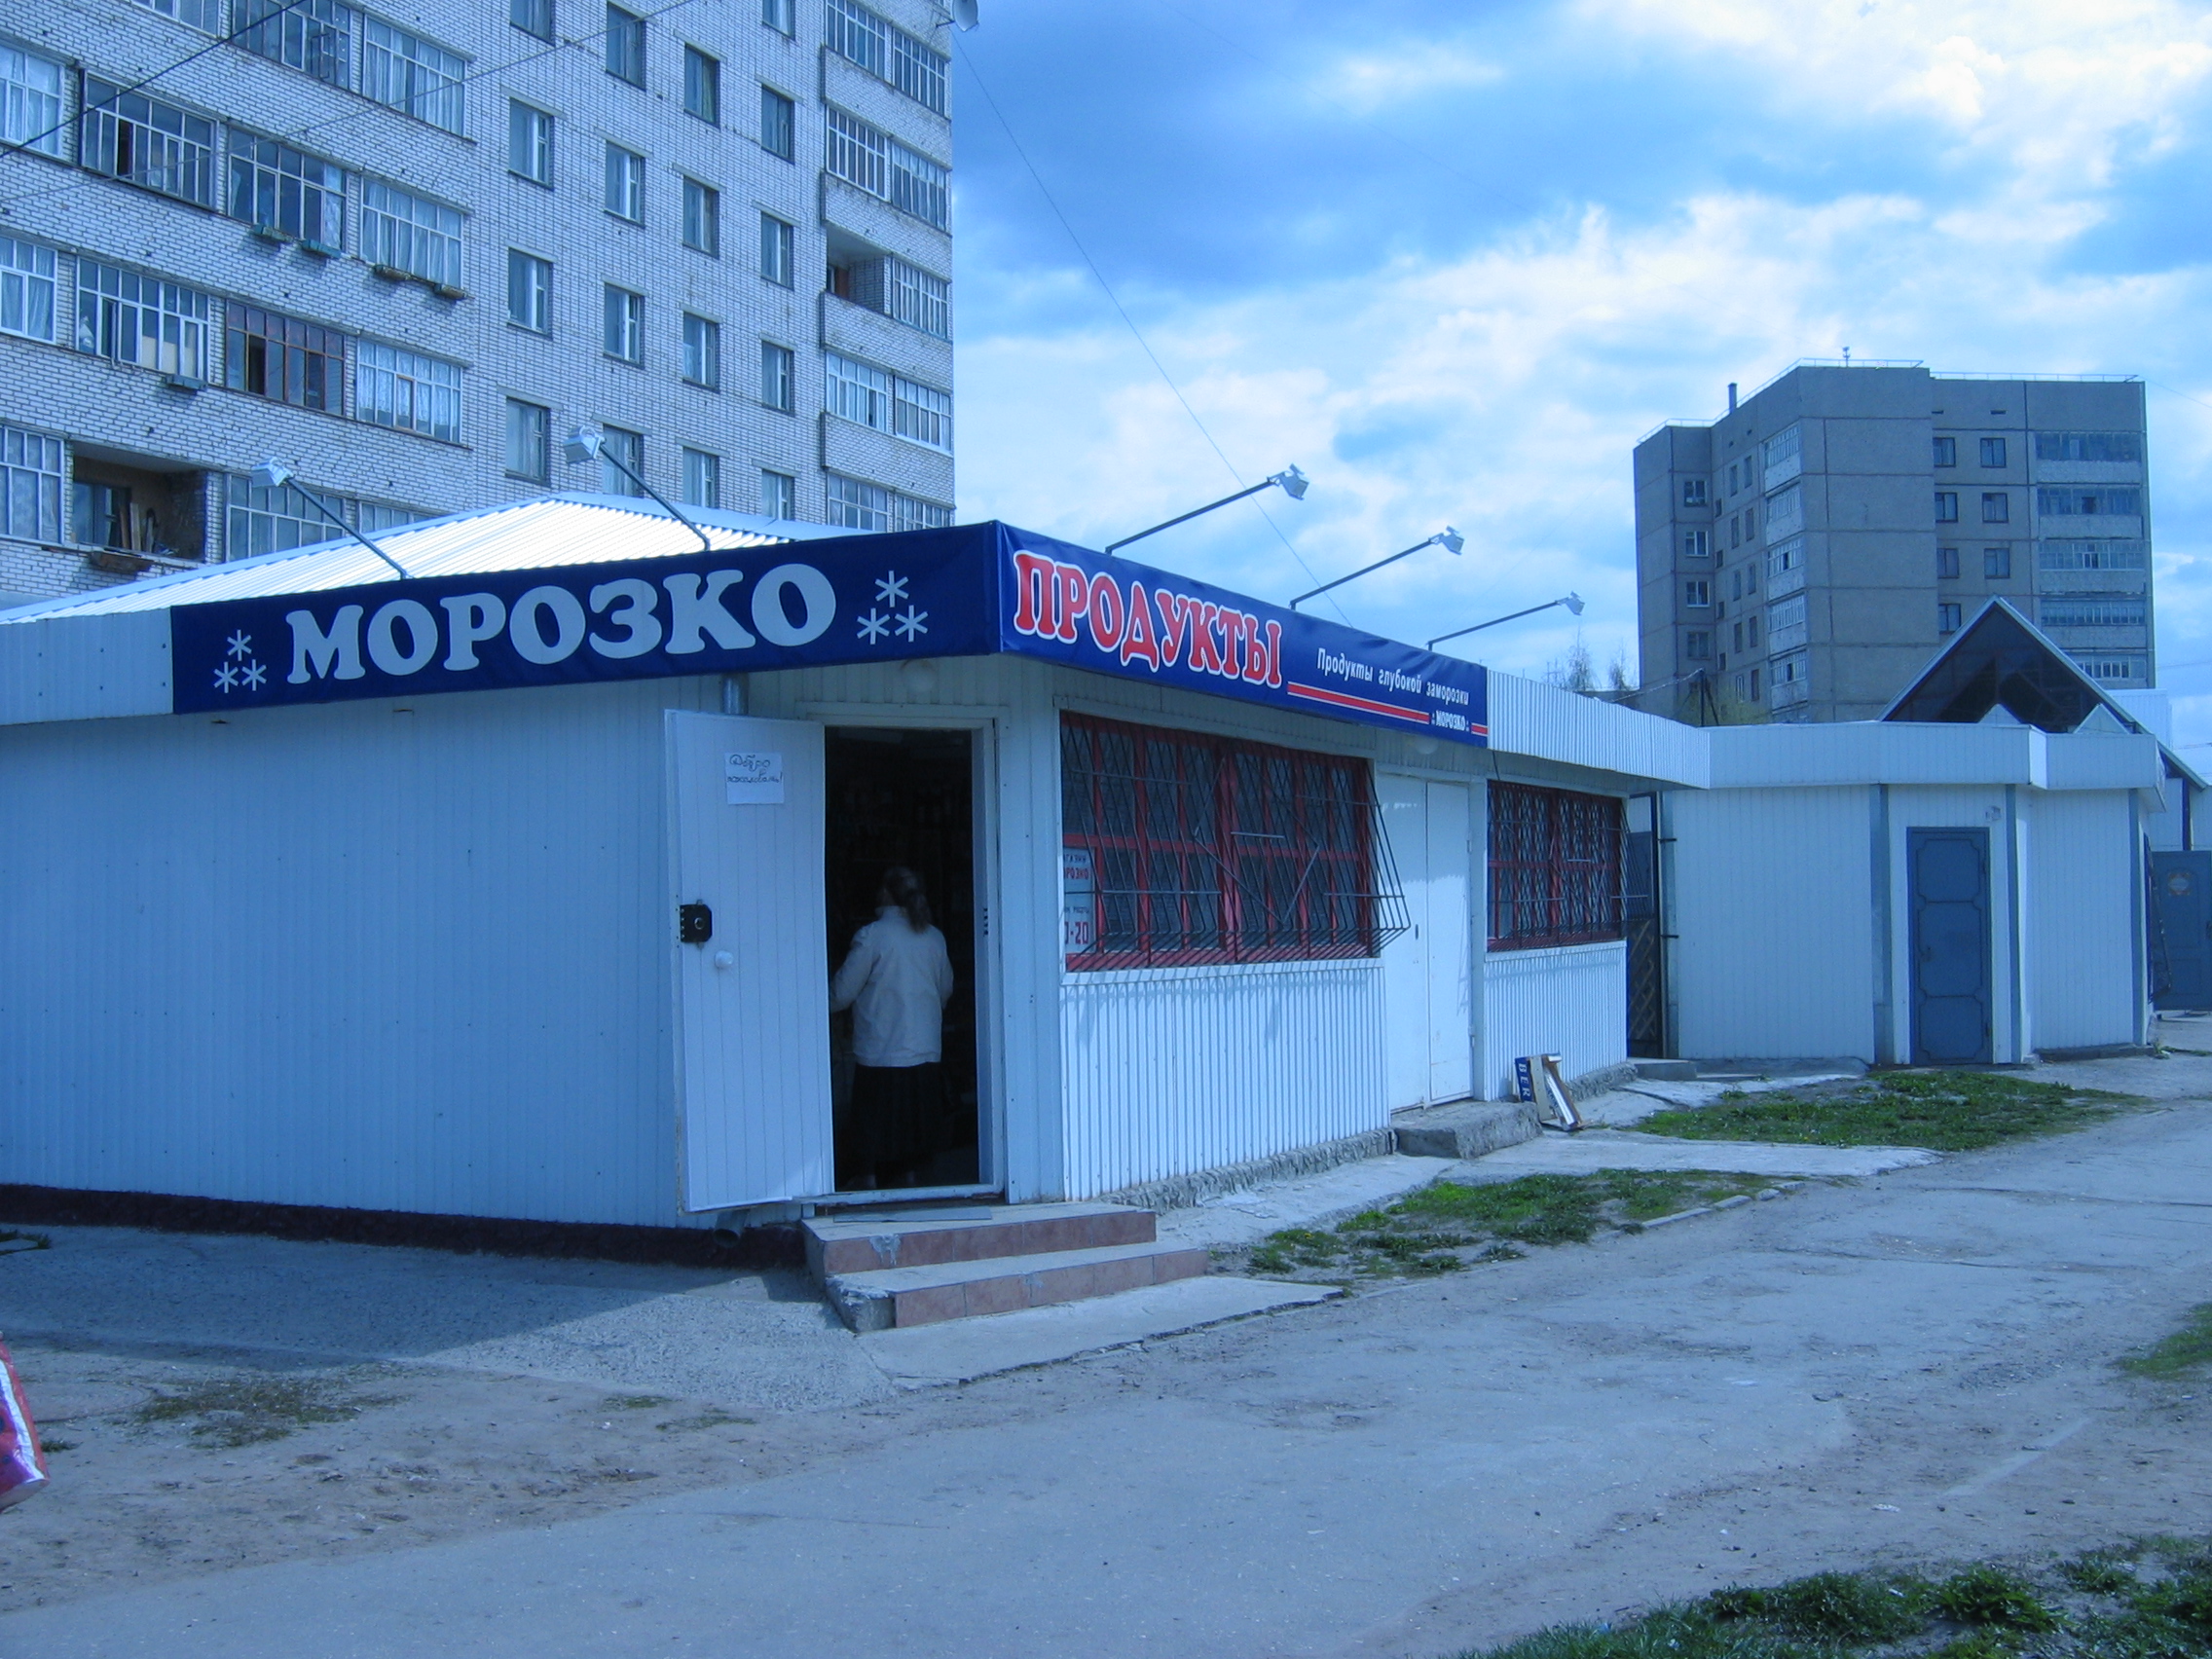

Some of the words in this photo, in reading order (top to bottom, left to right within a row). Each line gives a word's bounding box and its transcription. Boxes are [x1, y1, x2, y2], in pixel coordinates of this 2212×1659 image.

[286, 564, 837, 684] МОРОЗКО
[1013, 549, 1282, 688] ПРОДУКТЫ
[1317, 647, 1374, 682] Продукты
[1379, 668, 1422, 694] глубокой
[1425, 682, 1470, 706] заморозки
